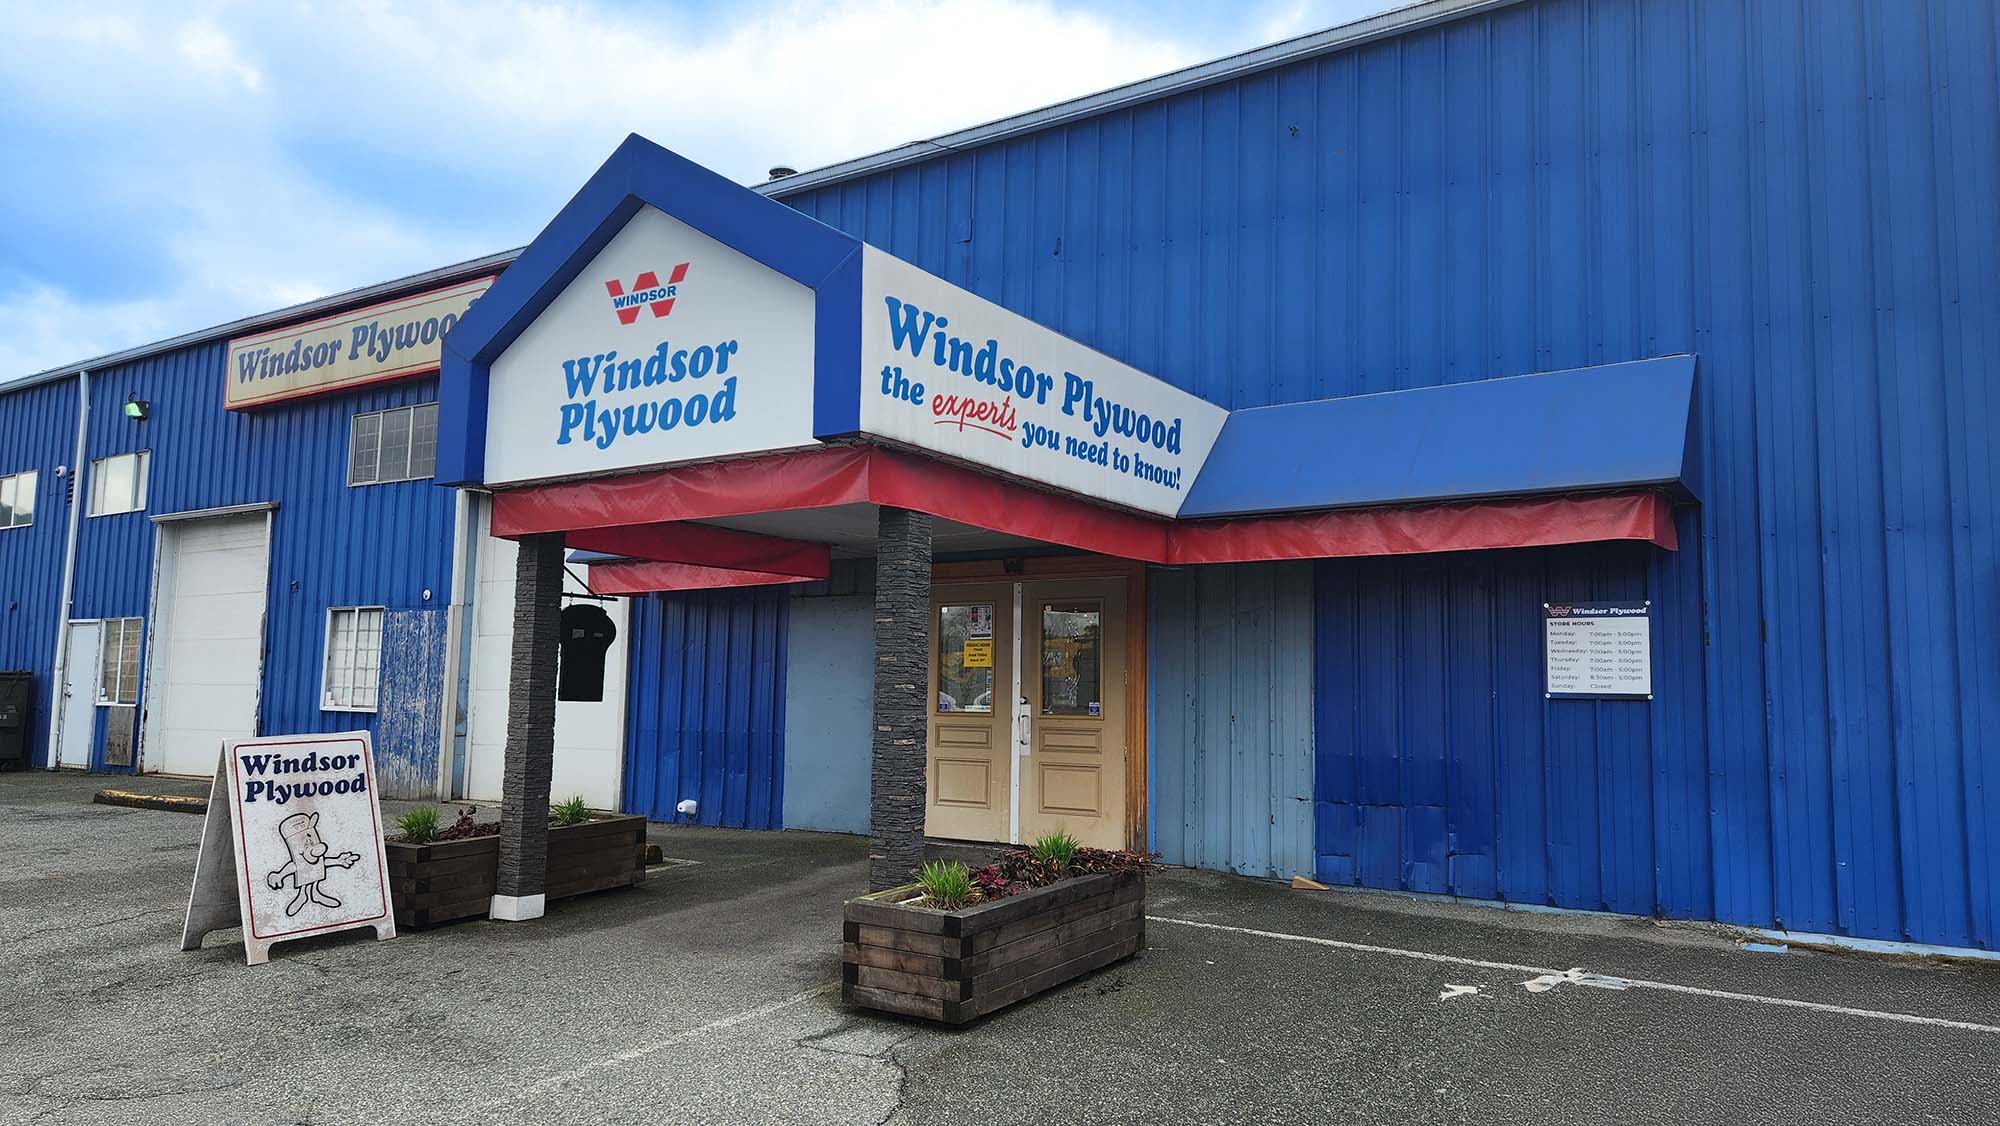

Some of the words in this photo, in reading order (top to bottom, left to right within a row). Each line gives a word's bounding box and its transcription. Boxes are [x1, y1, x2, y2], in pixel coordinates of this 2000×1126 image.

[613, 285, 677, 309] WINDSOR
[238, 337, 342, 384] Windsor
[348, 298, 480, 363] Plywoo
[562, 339, 738, 400] Windsor
[884, 295, 1054, 405] Windsor
[1061, 370, 1182, 455] Plywood
[556, 376, 738, 450] Plywood
[881, 365, 925, 405] the
[932, 393, 1017, 432] experts
[1022, 420, 1060, 448] you
[1066, 435, 1108, 466] need
[1112, 449, 1130, 474] to
[1134, 452, 1182, 490] know!
[1609, 607, 1647, 616] Plywood
[241, 752, 360, 776] Windsor
[245, 773, 367, 804] Plywood
